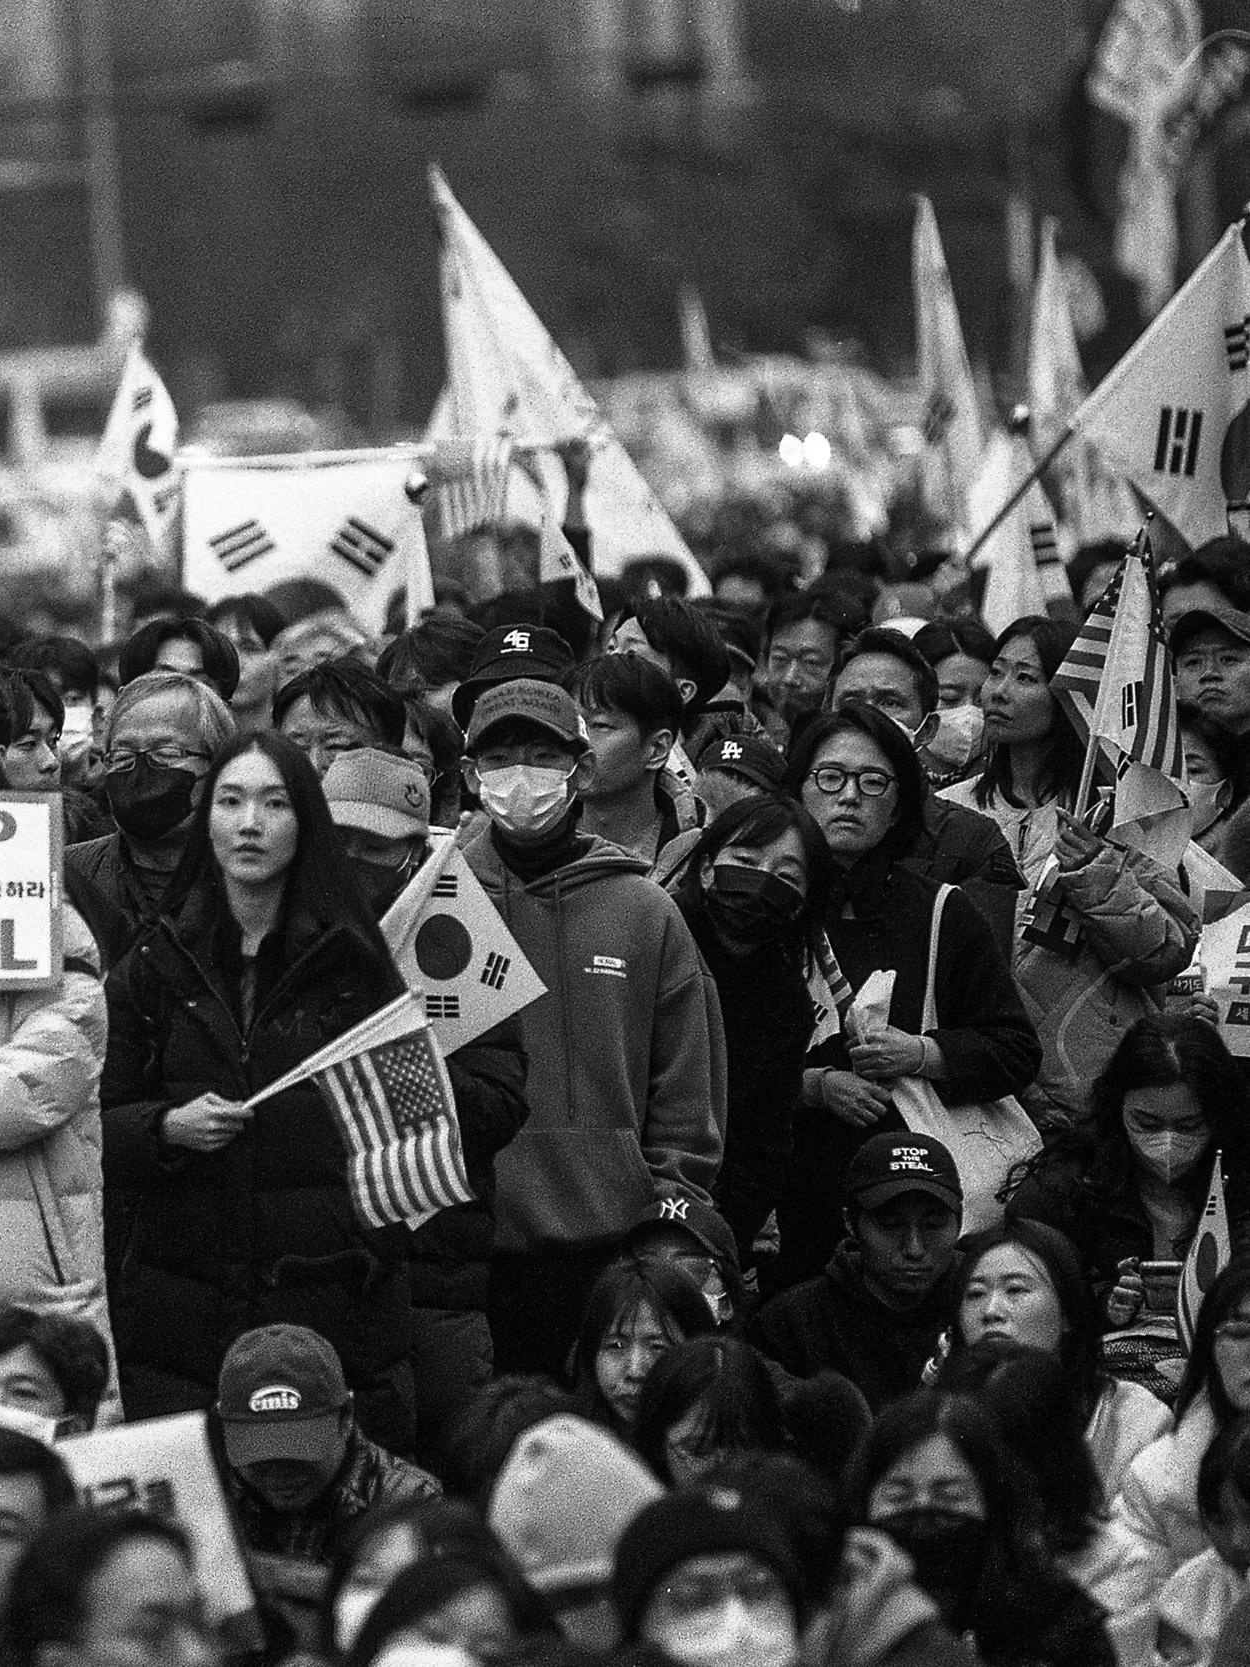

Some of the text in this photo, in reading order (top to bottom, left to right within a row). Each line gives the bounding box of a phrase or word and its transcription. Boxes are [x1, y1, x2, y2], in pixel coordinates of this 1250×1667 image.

[503, 629, 531, 648] 46
[720, 740, 743, 760] LA
[892, 1147, 929, 1156] STOP
[890, 1161, 934, 1172] STEAL
[659, 1197, 690, 1220] NY
